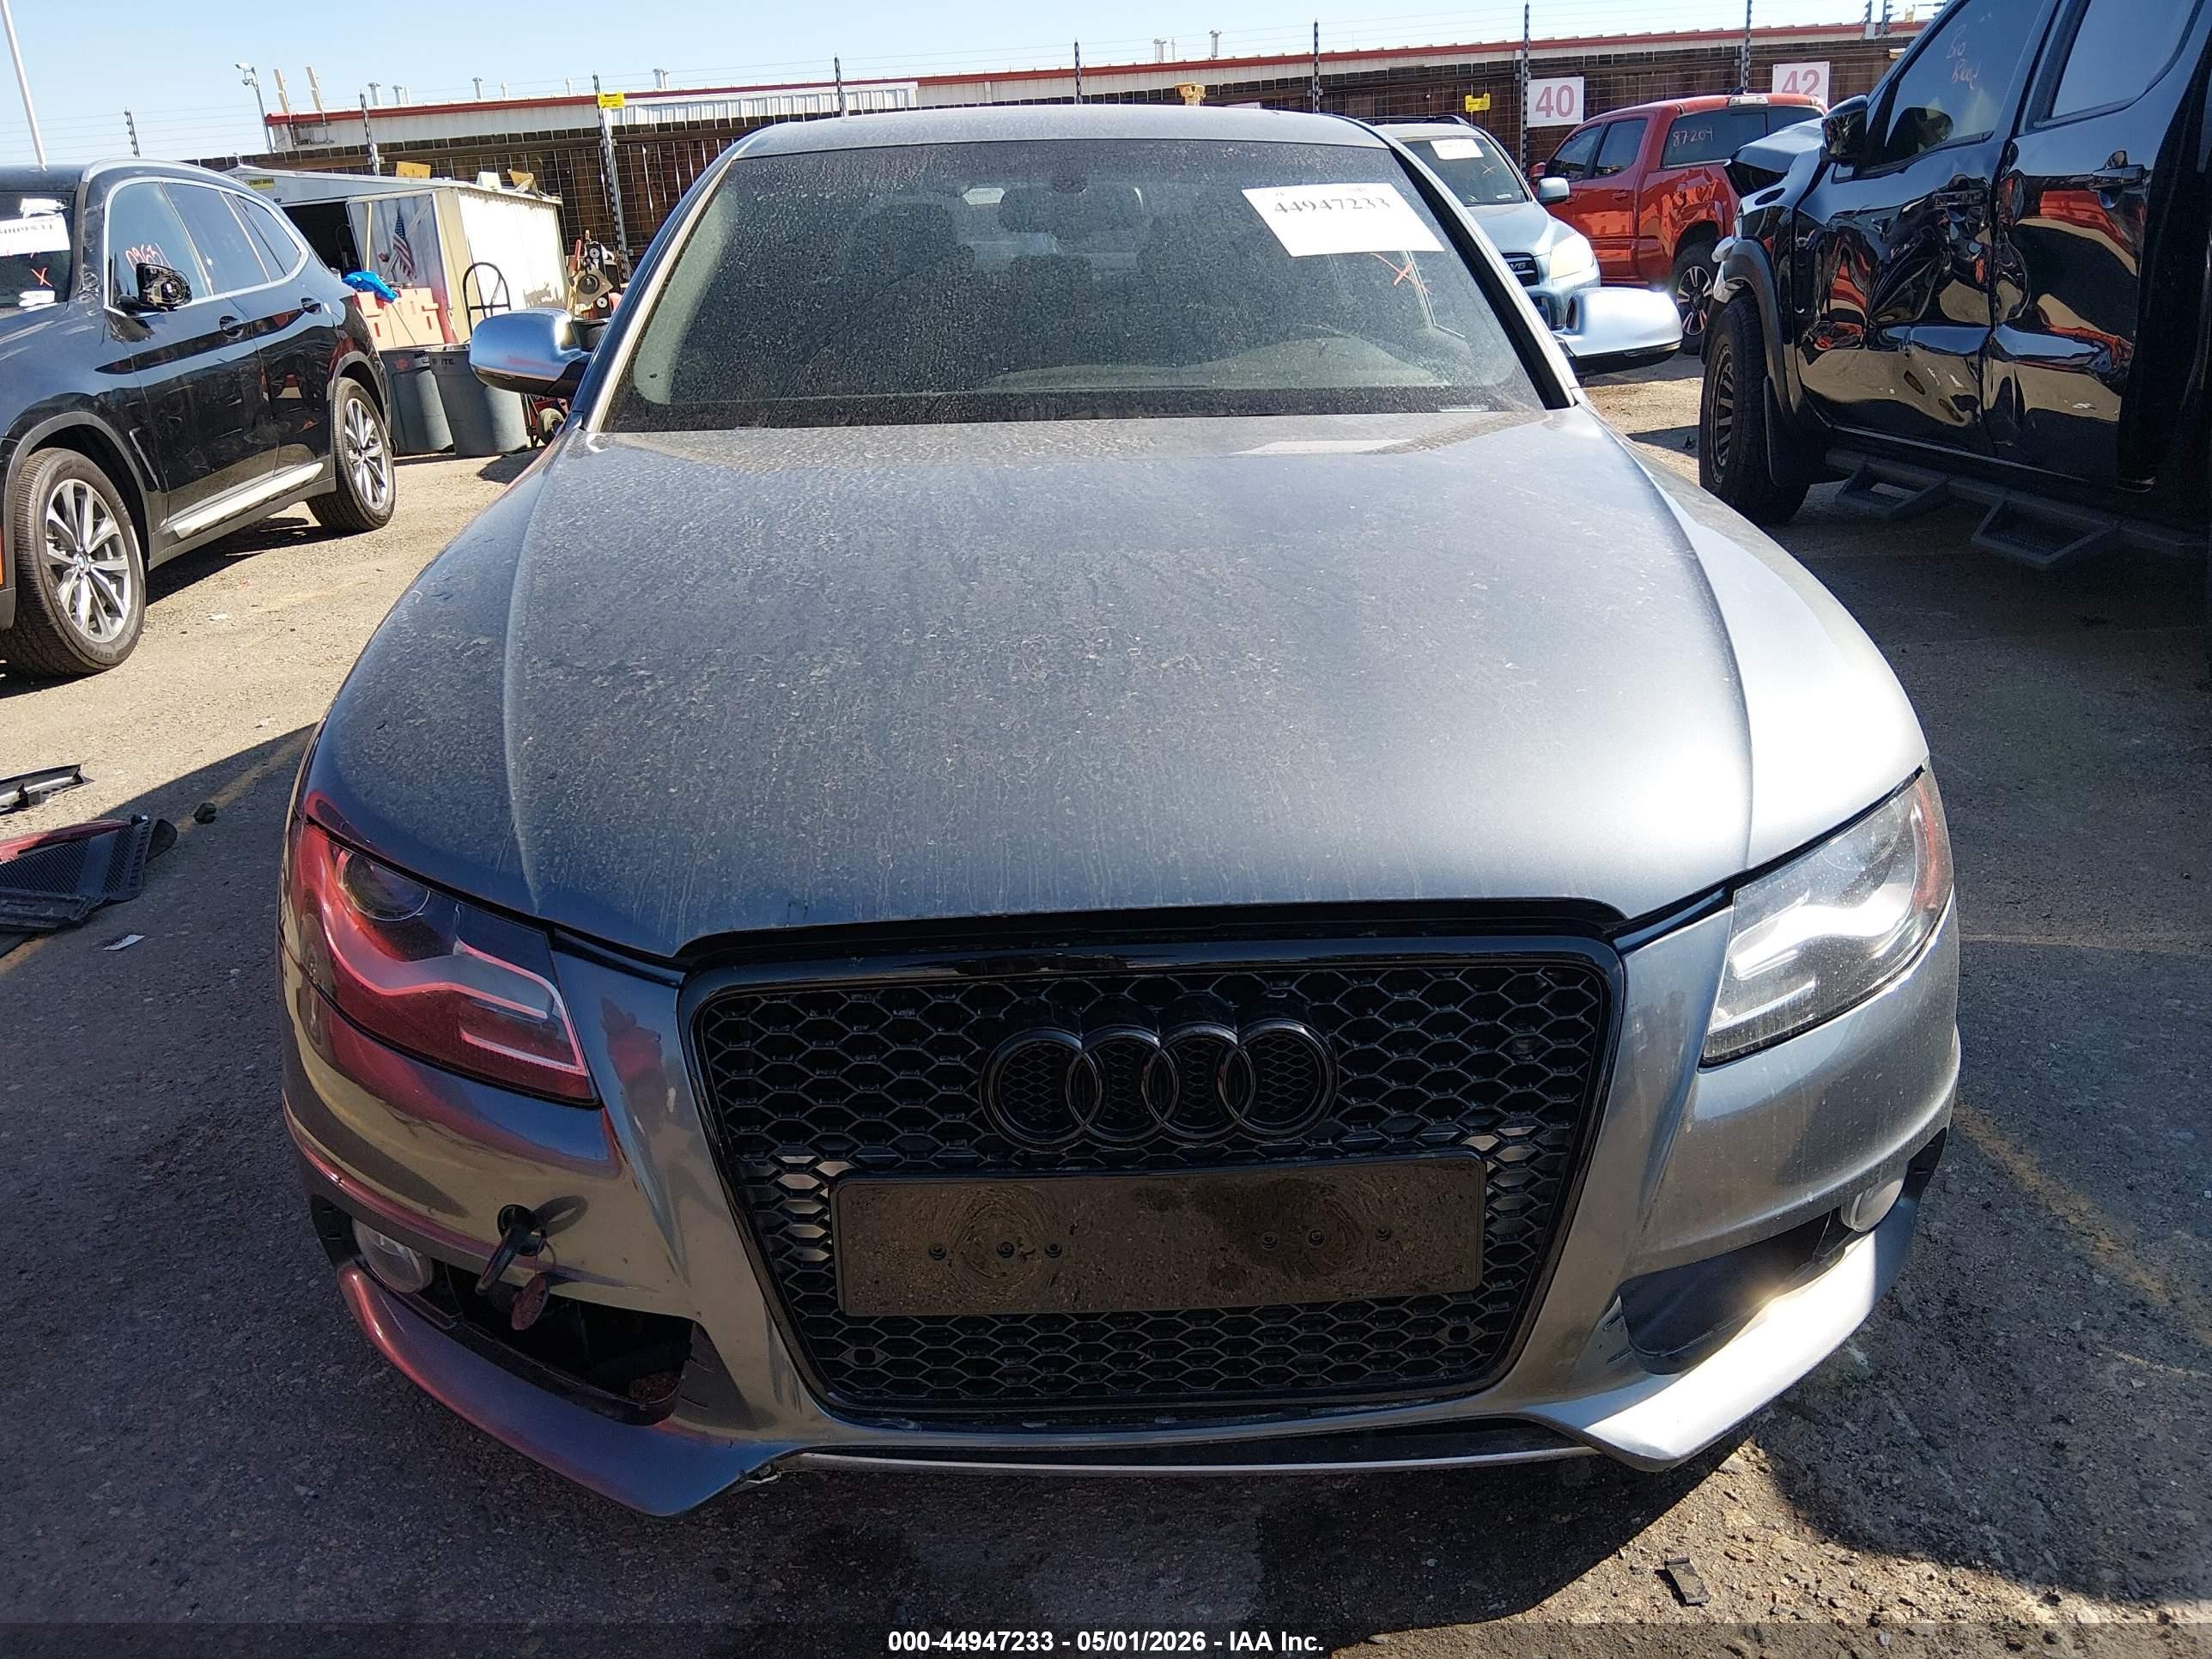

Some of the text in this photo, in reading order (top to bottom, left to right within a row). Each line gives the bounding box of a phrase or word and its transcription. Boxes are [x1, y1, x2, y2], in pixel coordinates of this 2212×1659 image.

[1782, 70, 1820, 94] 42
[1535, 84, 1574, 118] 40
[1274, 198, 1390, 214] 44947233
